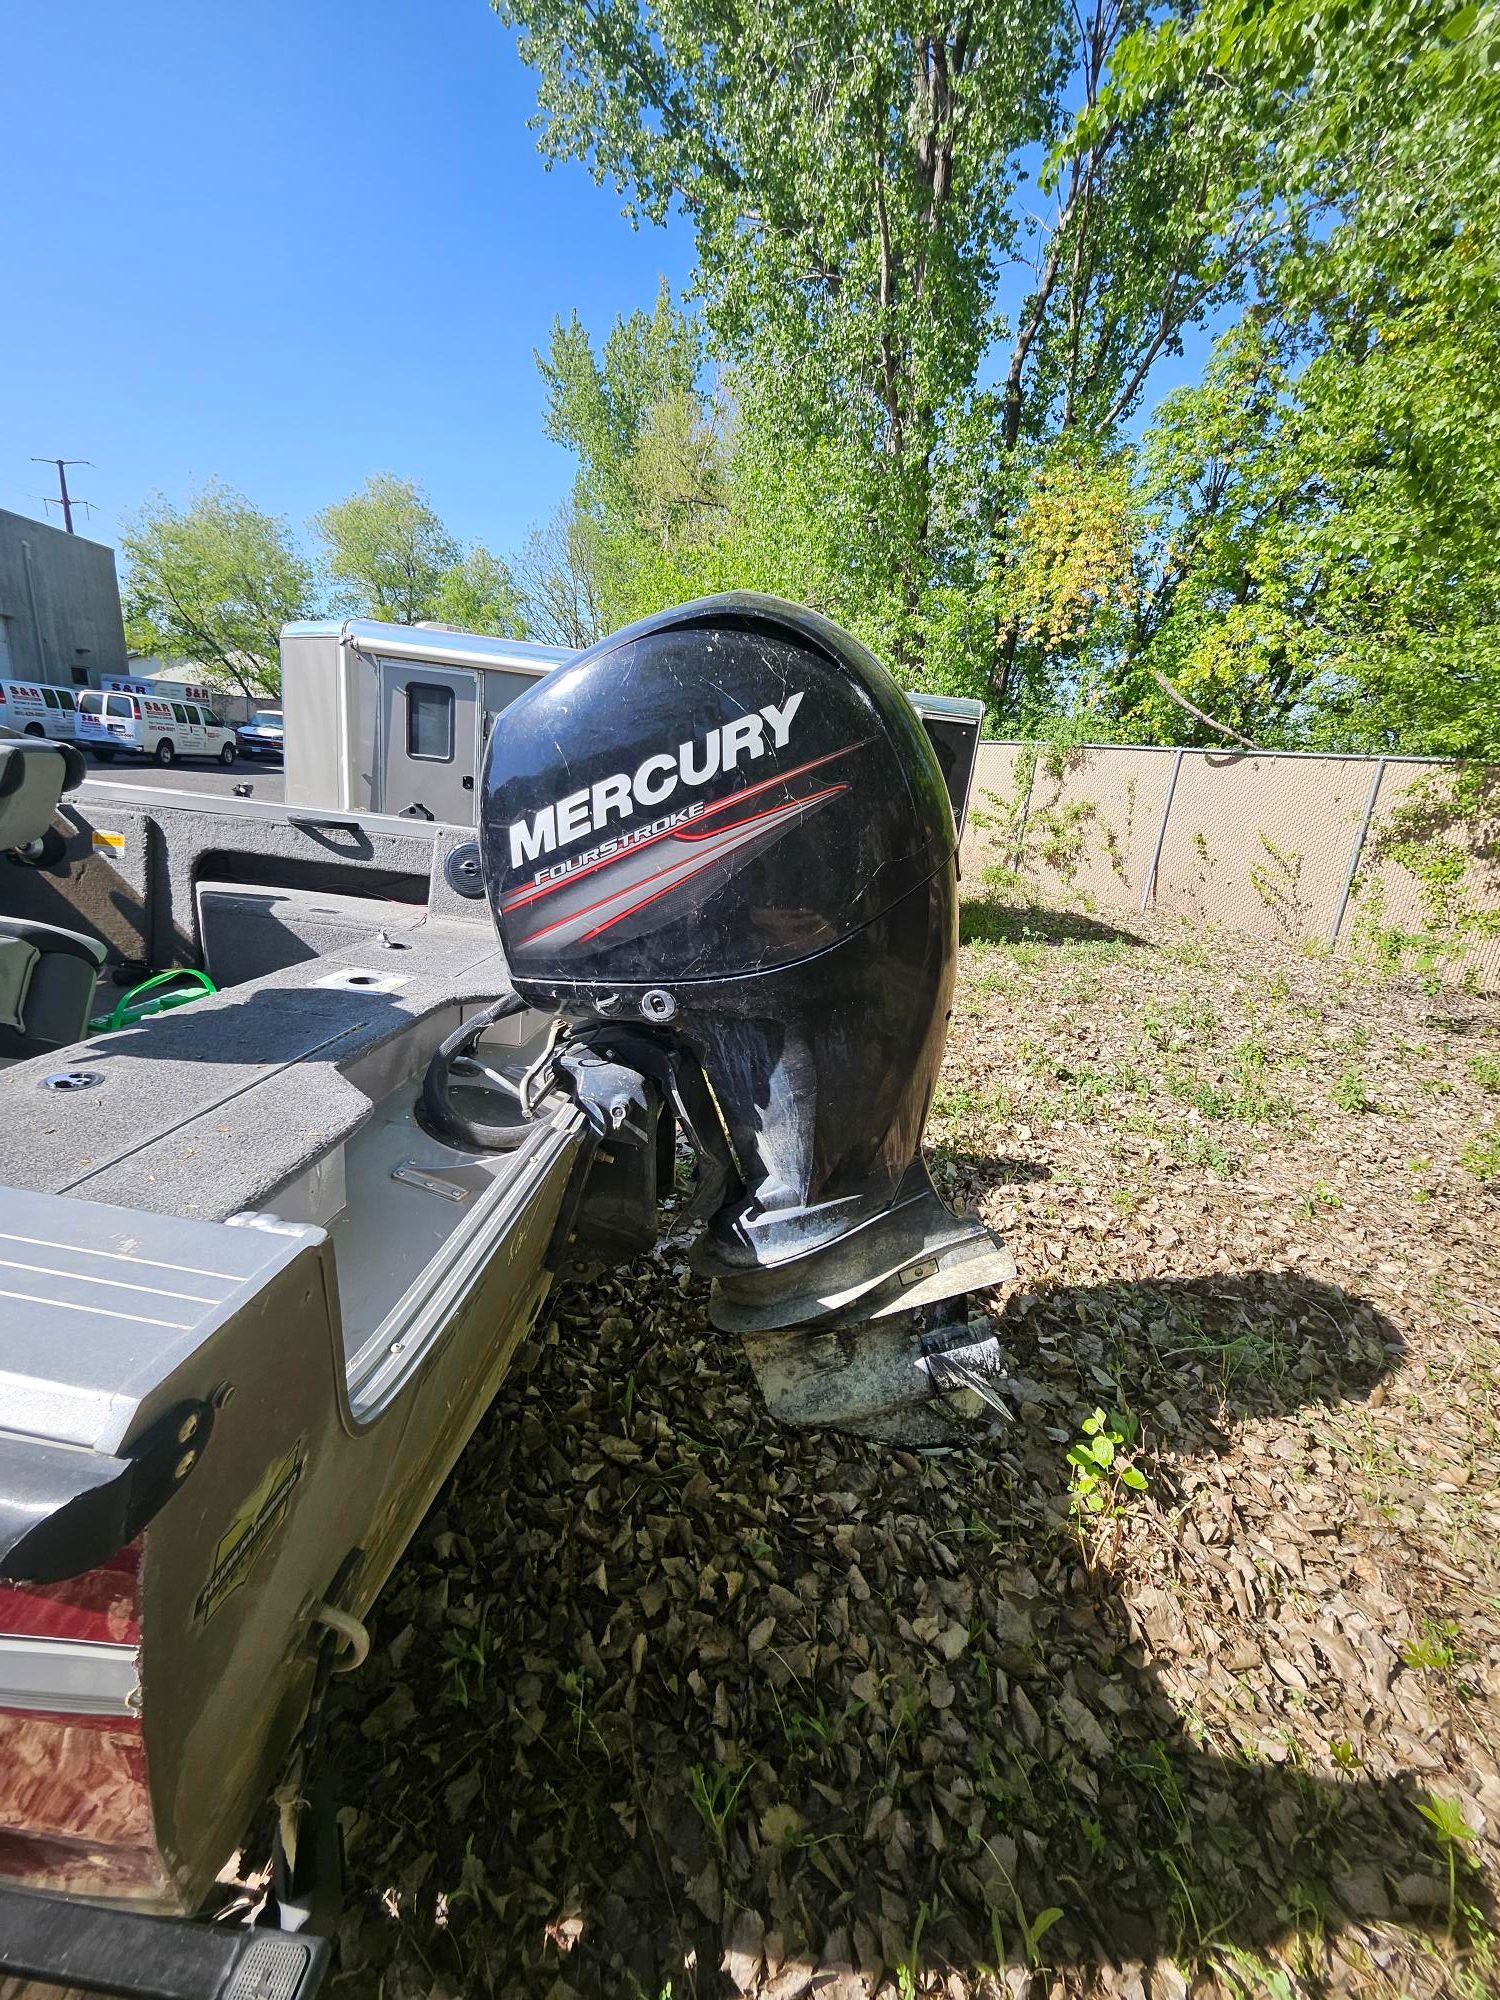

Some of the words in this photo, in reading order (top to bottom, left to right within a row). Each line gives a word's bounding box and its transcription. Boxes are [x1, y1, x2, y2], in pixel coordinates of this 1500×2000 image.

[9, 685, 40, 698] S&R
[185, 686, 209, 699] S&R
[144, 701, 171, 712] S&R
[509, 691, 805, 869] MERCURY
[534, 801, 705, 886] FOURSTROKE
